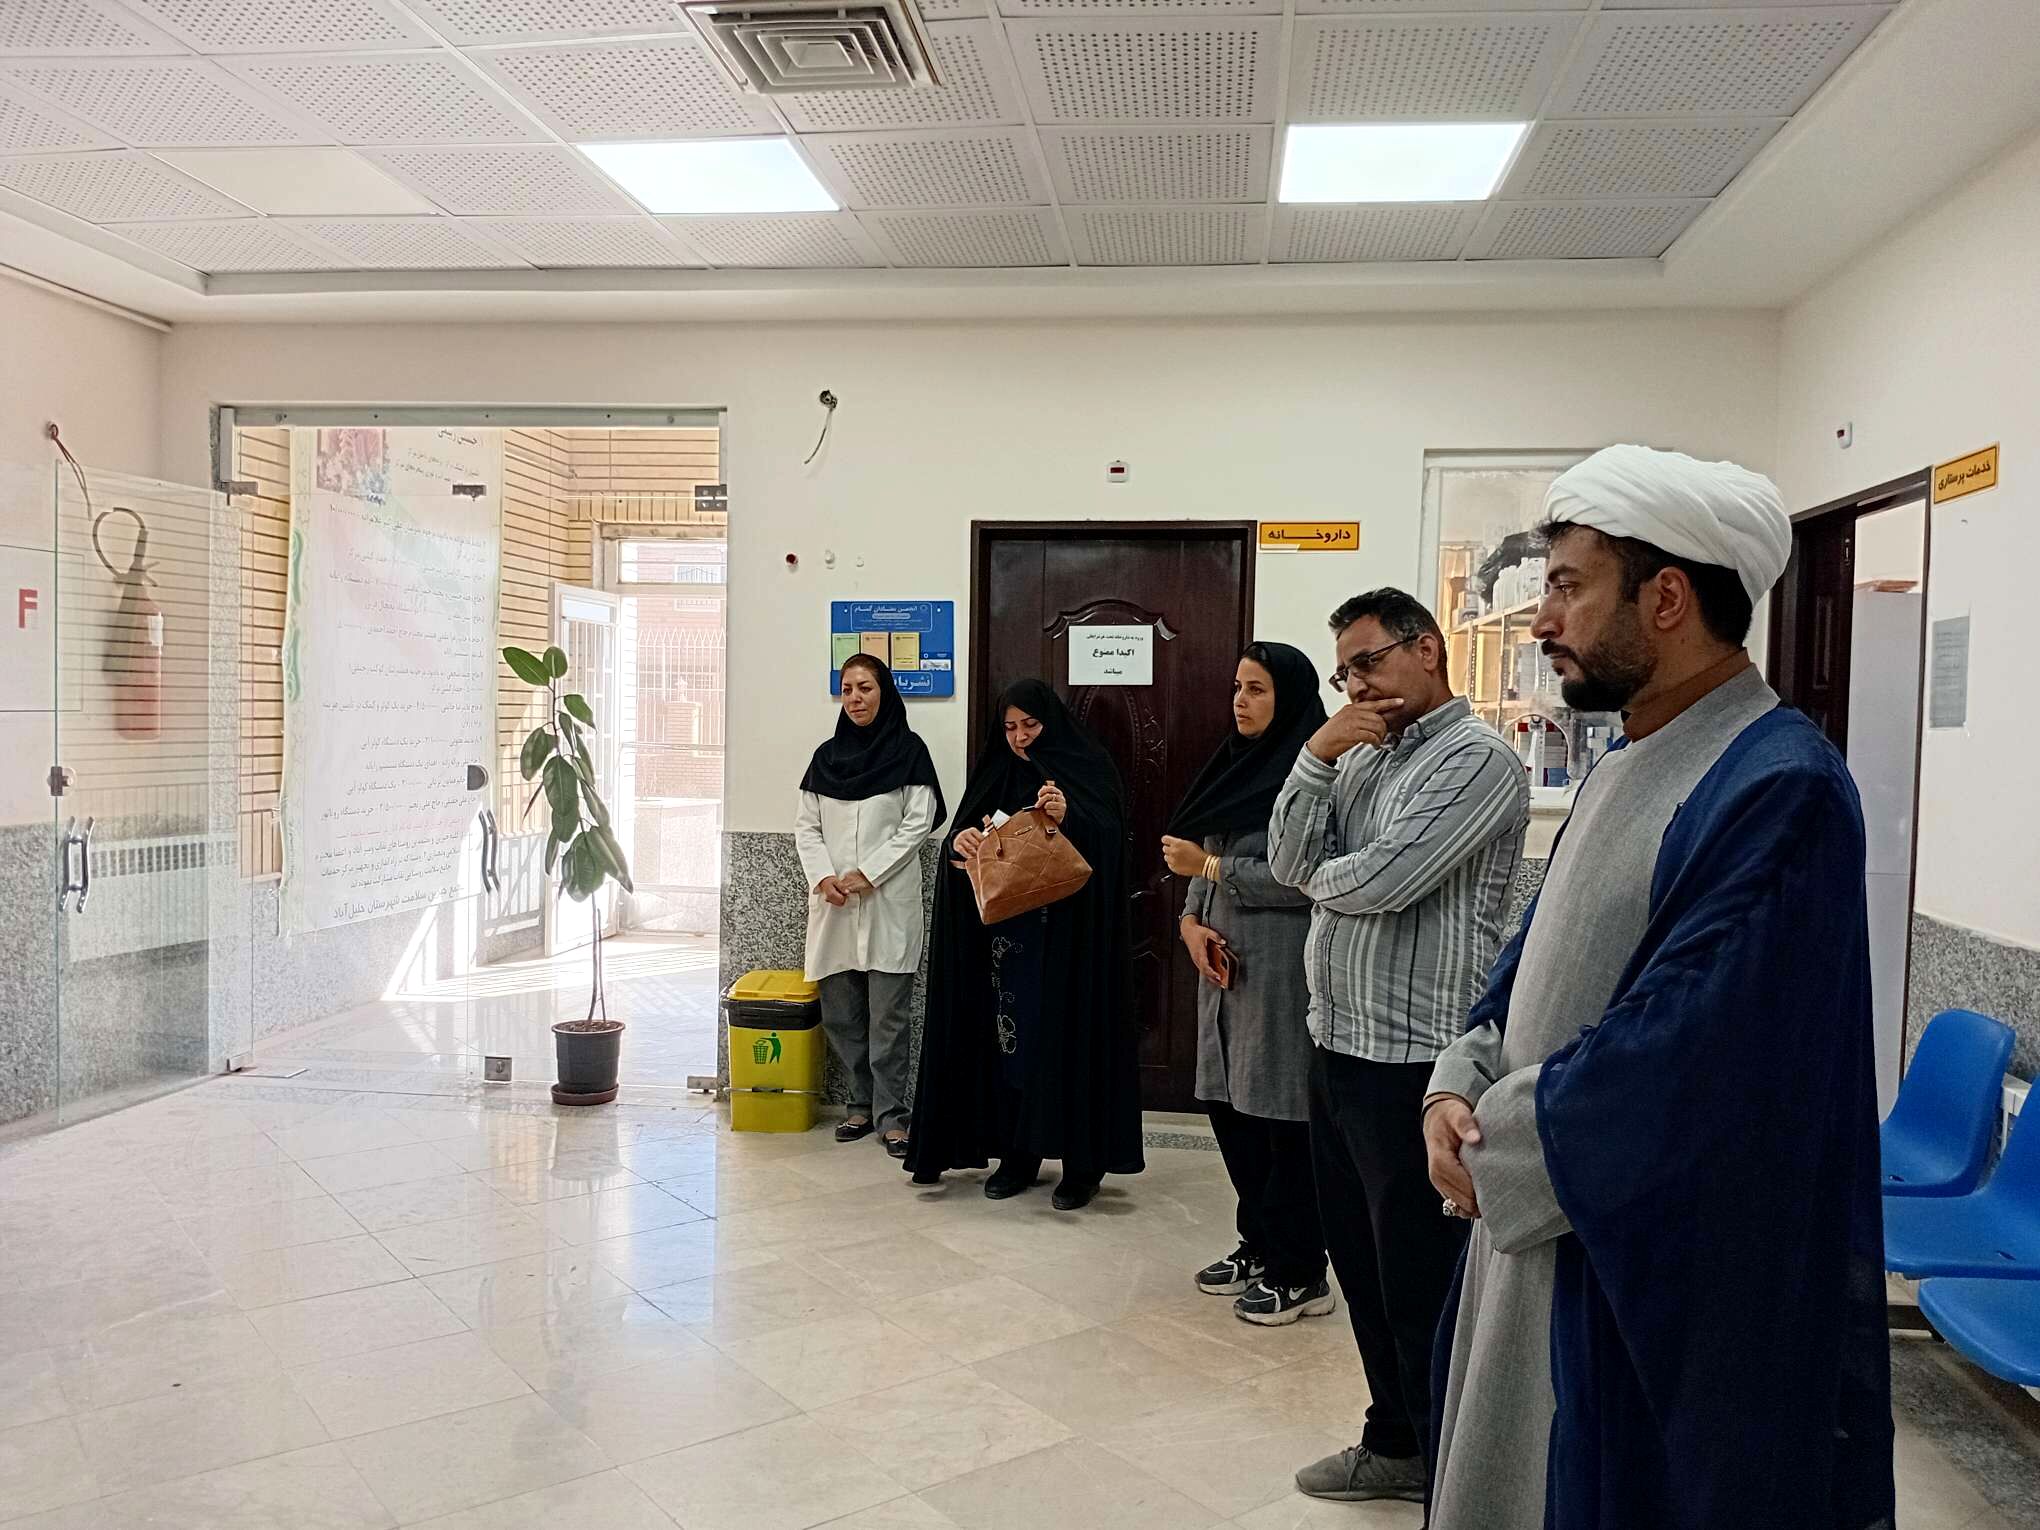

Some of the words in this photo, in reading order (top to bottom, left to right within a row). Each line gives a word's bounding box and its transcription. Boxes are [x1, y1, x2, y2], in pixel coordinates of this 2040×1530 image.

[1966, 461, 1991, 478] خدمات
[1938, 472, 1965, 490] پرستاری
[1268, 529, 1351, 543] داروخانه
[19, 589, 38, 629] F
[894, 675, 931, 690] نشریا
